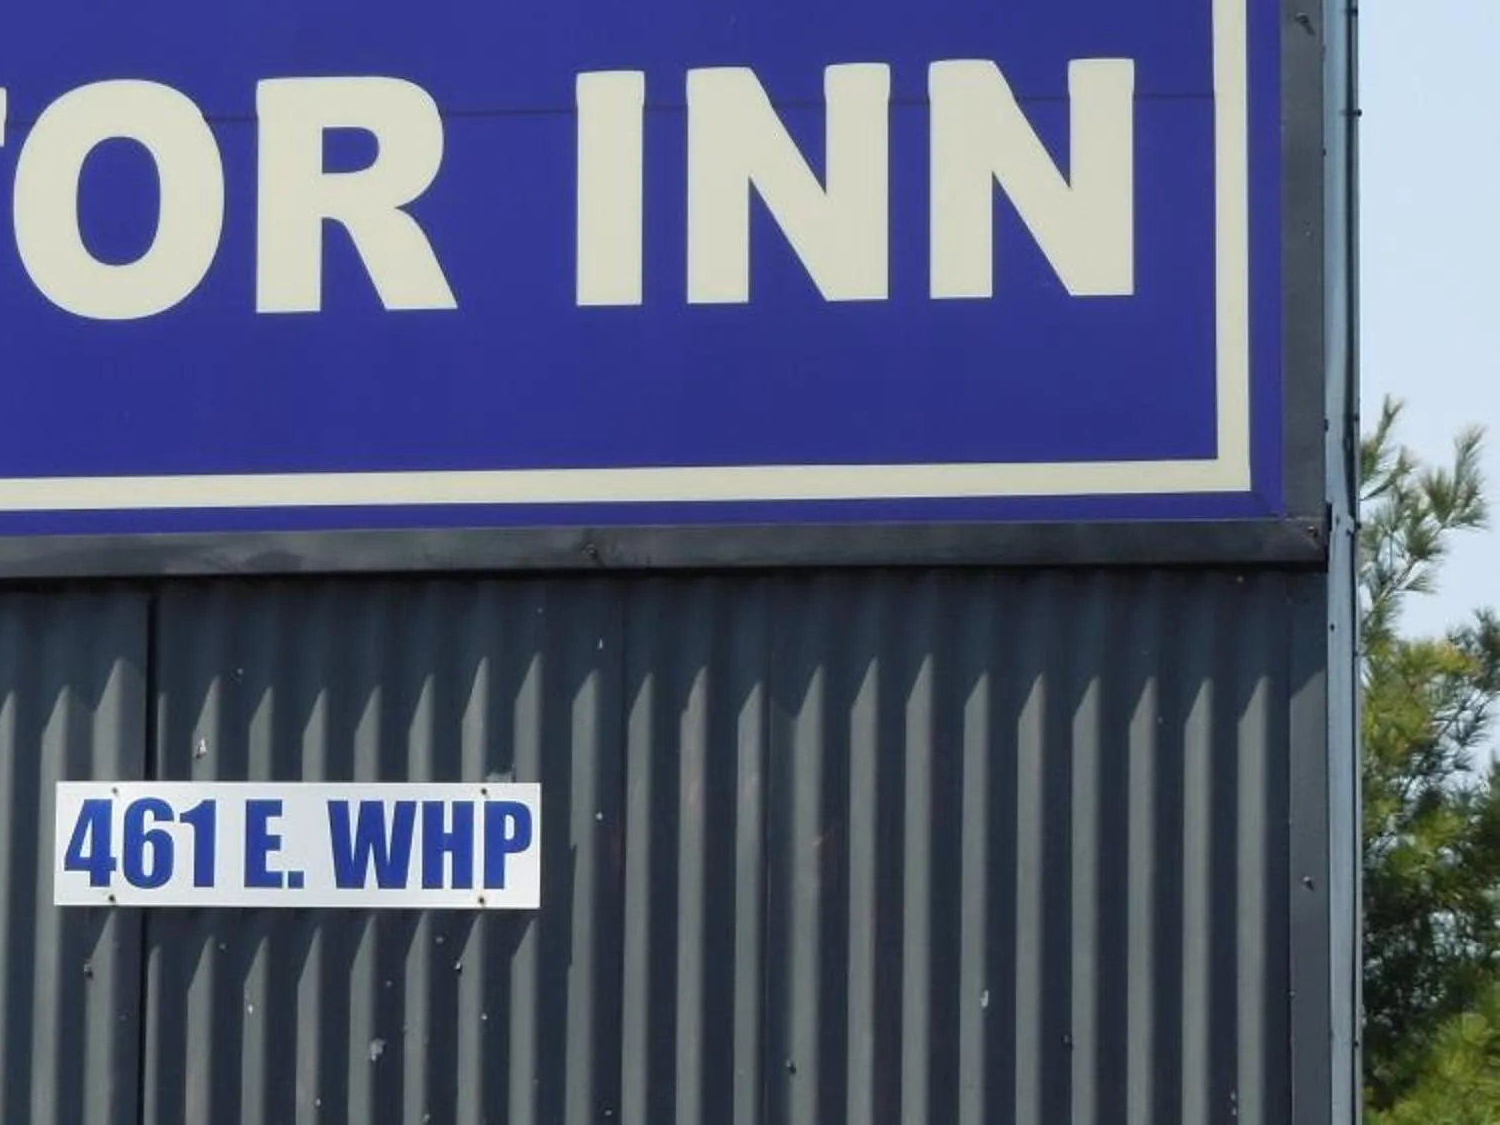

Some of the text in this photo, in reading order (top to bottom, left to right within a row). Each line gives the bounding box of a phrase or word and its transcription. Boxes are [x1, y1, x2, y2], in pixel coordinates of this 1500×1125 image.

[575, 58, 1136, 307] INN
[64, 797, 532, 890] 461 E. WHP
